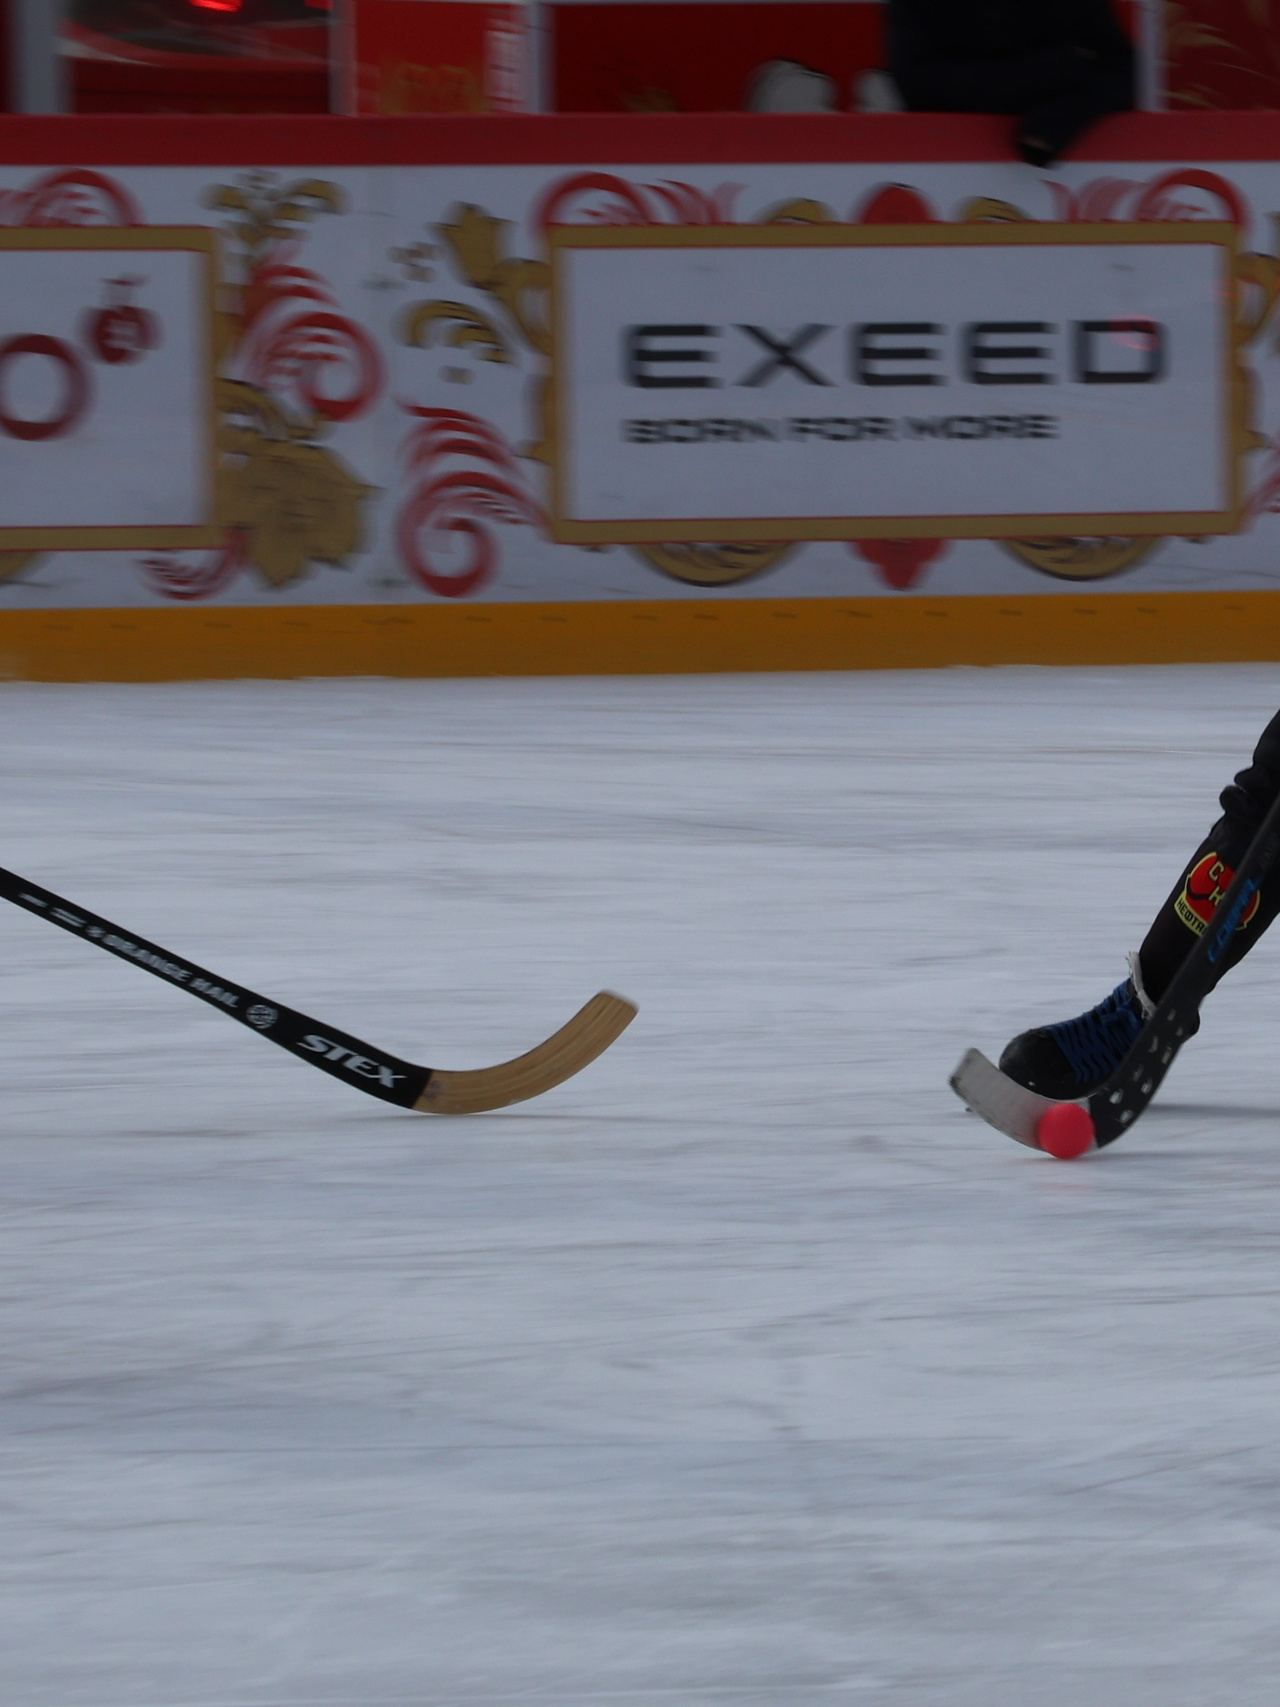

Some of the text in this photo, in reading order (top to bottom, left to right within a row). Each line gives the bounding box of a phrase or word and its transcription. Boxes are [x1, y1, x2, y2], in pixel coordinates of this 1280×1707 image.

[624, 321, 1170, 388] EXEED
[622, 414, 1062, 444] BORN FOR MORE
[101, 933, 240, 1008] ORANGE HAIL
[296, 1034, 408, 1088] STEX
